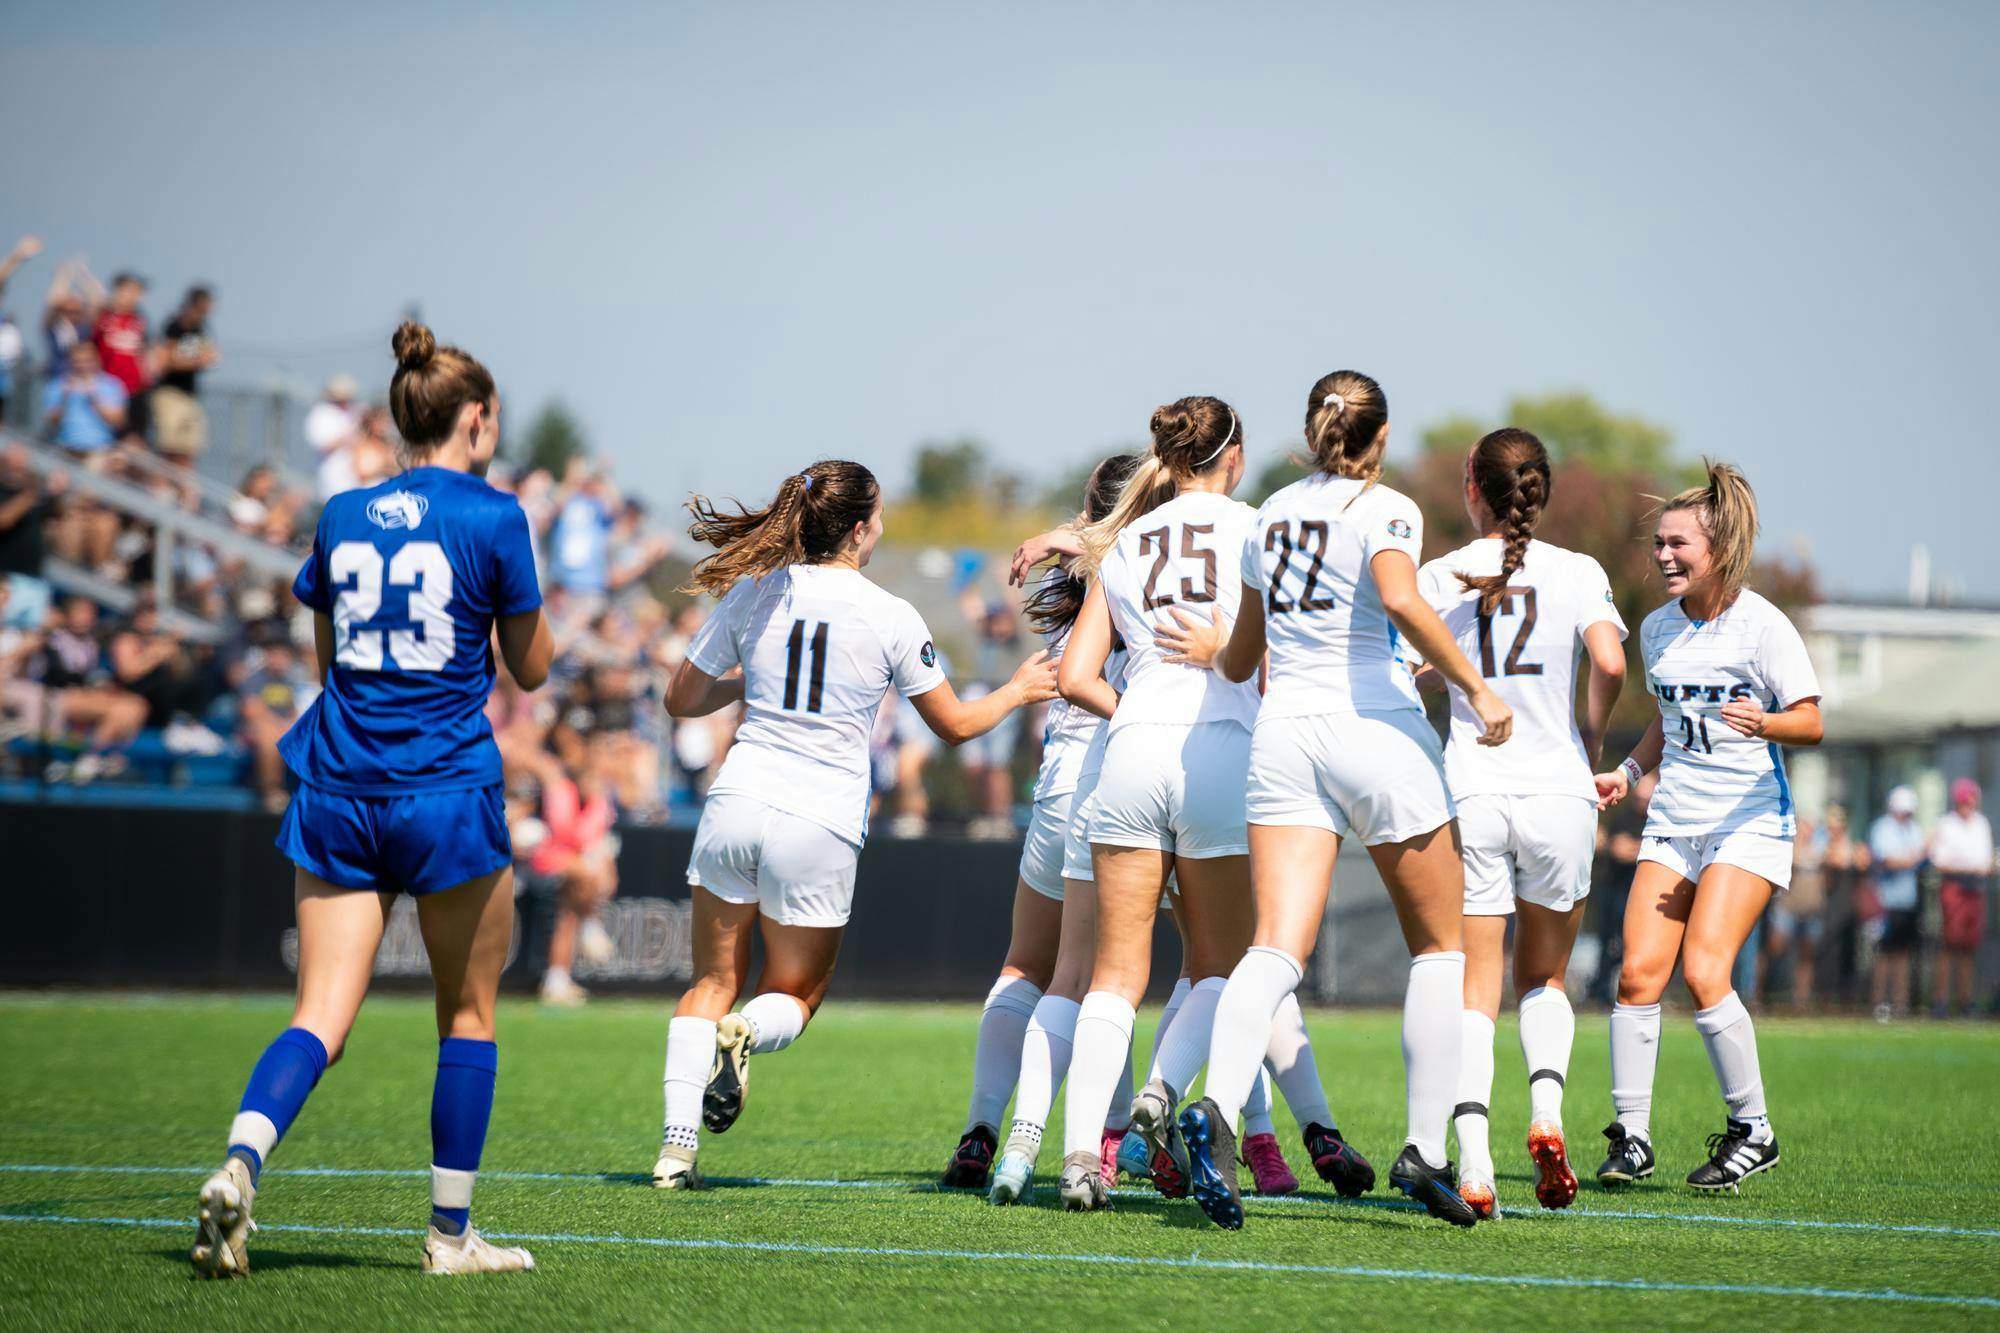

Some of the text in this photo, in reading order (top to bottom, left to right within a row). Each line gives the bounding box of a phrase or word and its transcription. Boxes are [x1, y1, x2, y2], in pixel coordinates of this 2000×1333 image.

[329, 540, 456, 672] 23
[1139, 522, 1217, 612] 25
[1264, 519, 1335, 615] 22
[782, 618, 830, 714] 11
[1475, 586, 1544, 679] 12
[1680, 713, 1712, 754] 21
